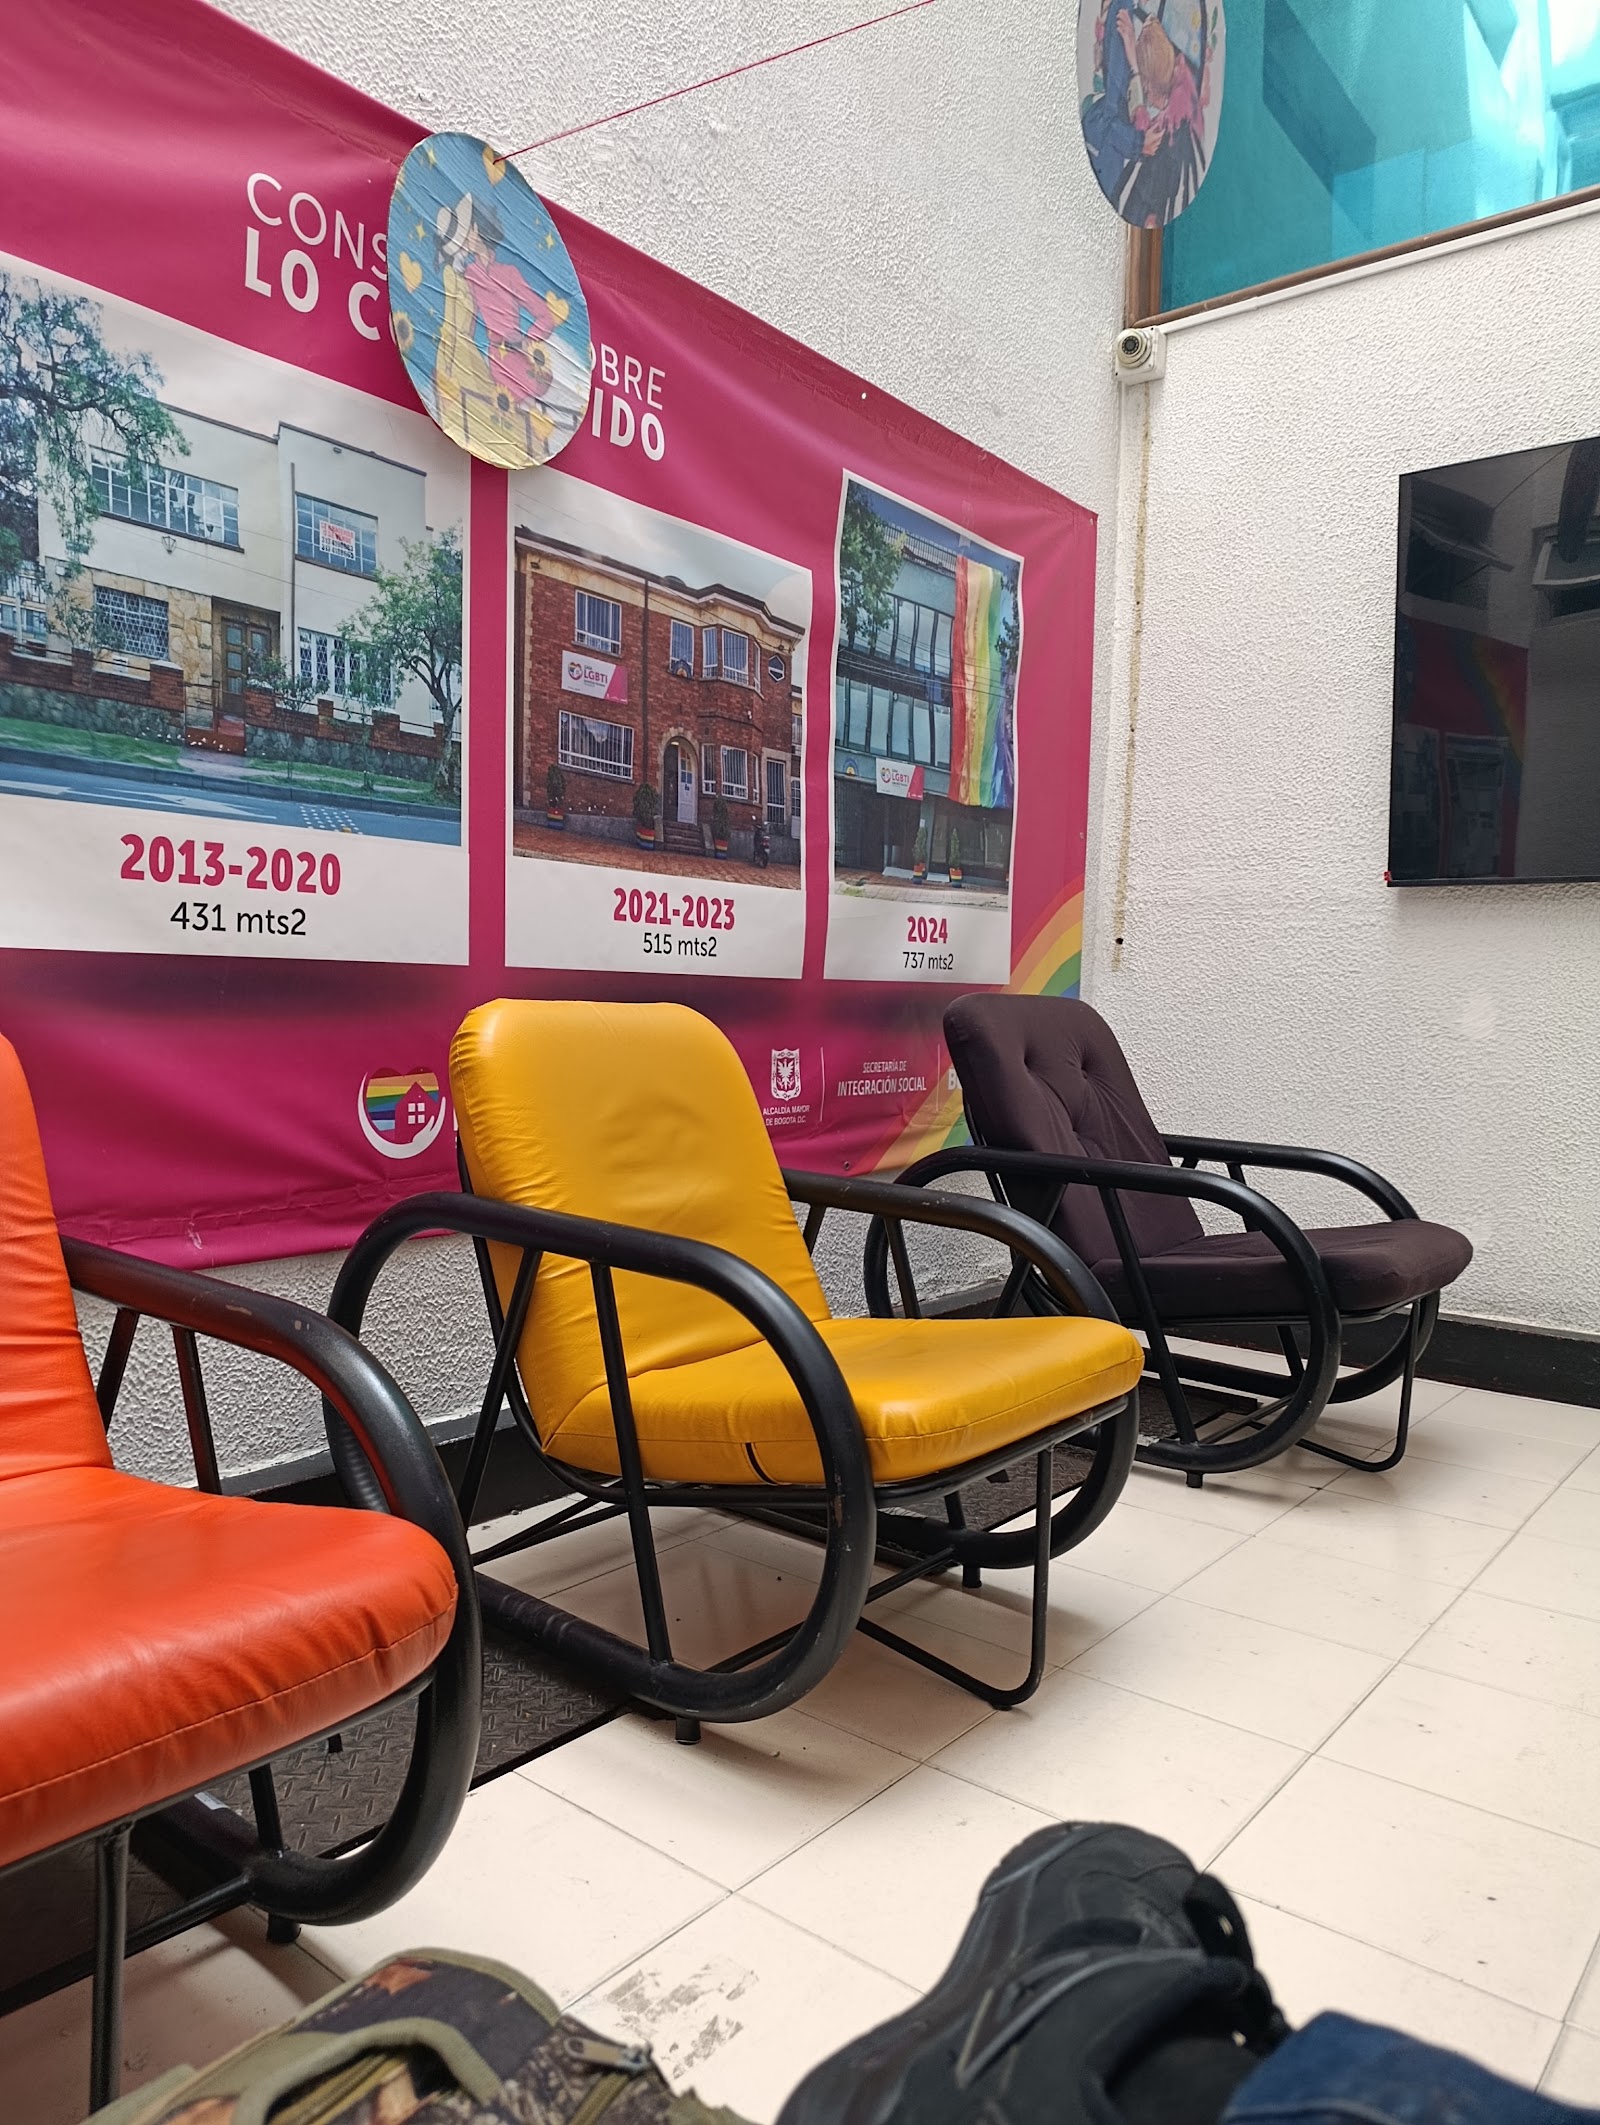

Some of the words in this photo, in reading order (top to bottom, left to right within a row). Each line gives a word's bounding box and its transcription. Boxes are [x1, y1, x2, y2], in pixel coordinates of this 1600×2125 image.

[245, 226, 320, 313] LO
[584, 669, 608, 684] LGBTI
[892, 772, 910, 784] LGBTI
[120, 833, 341, 896] 2013-2020
[170, 901, 226, 932] 431
[236, 908, 306, 936] mts2
[613, 887, 736, 931] 2021-2023
[907, 916, 948, 944] 2024
[643, 932, 672, 955] 515
[678, 936, 718, 957] mts2
[902, 951, 925, 969] 737
[928, 953, 954, 970] mts2
[862, 1059, 898, 1074] SECRETARÍA
[899, 1060, 907, 1072] DE
[837, 1075, 897, 1097] INTEGRACIÓN
[898, 1076, 927, 1093] SOCIAL
[763, 1104, 790, 1116] ALCALDÍA
[791, 1104, 810, 1113] MAYOR
[766, 1117, 773, 1126] DE
[774, 1115, 796, 1126] BOGOTÁ
